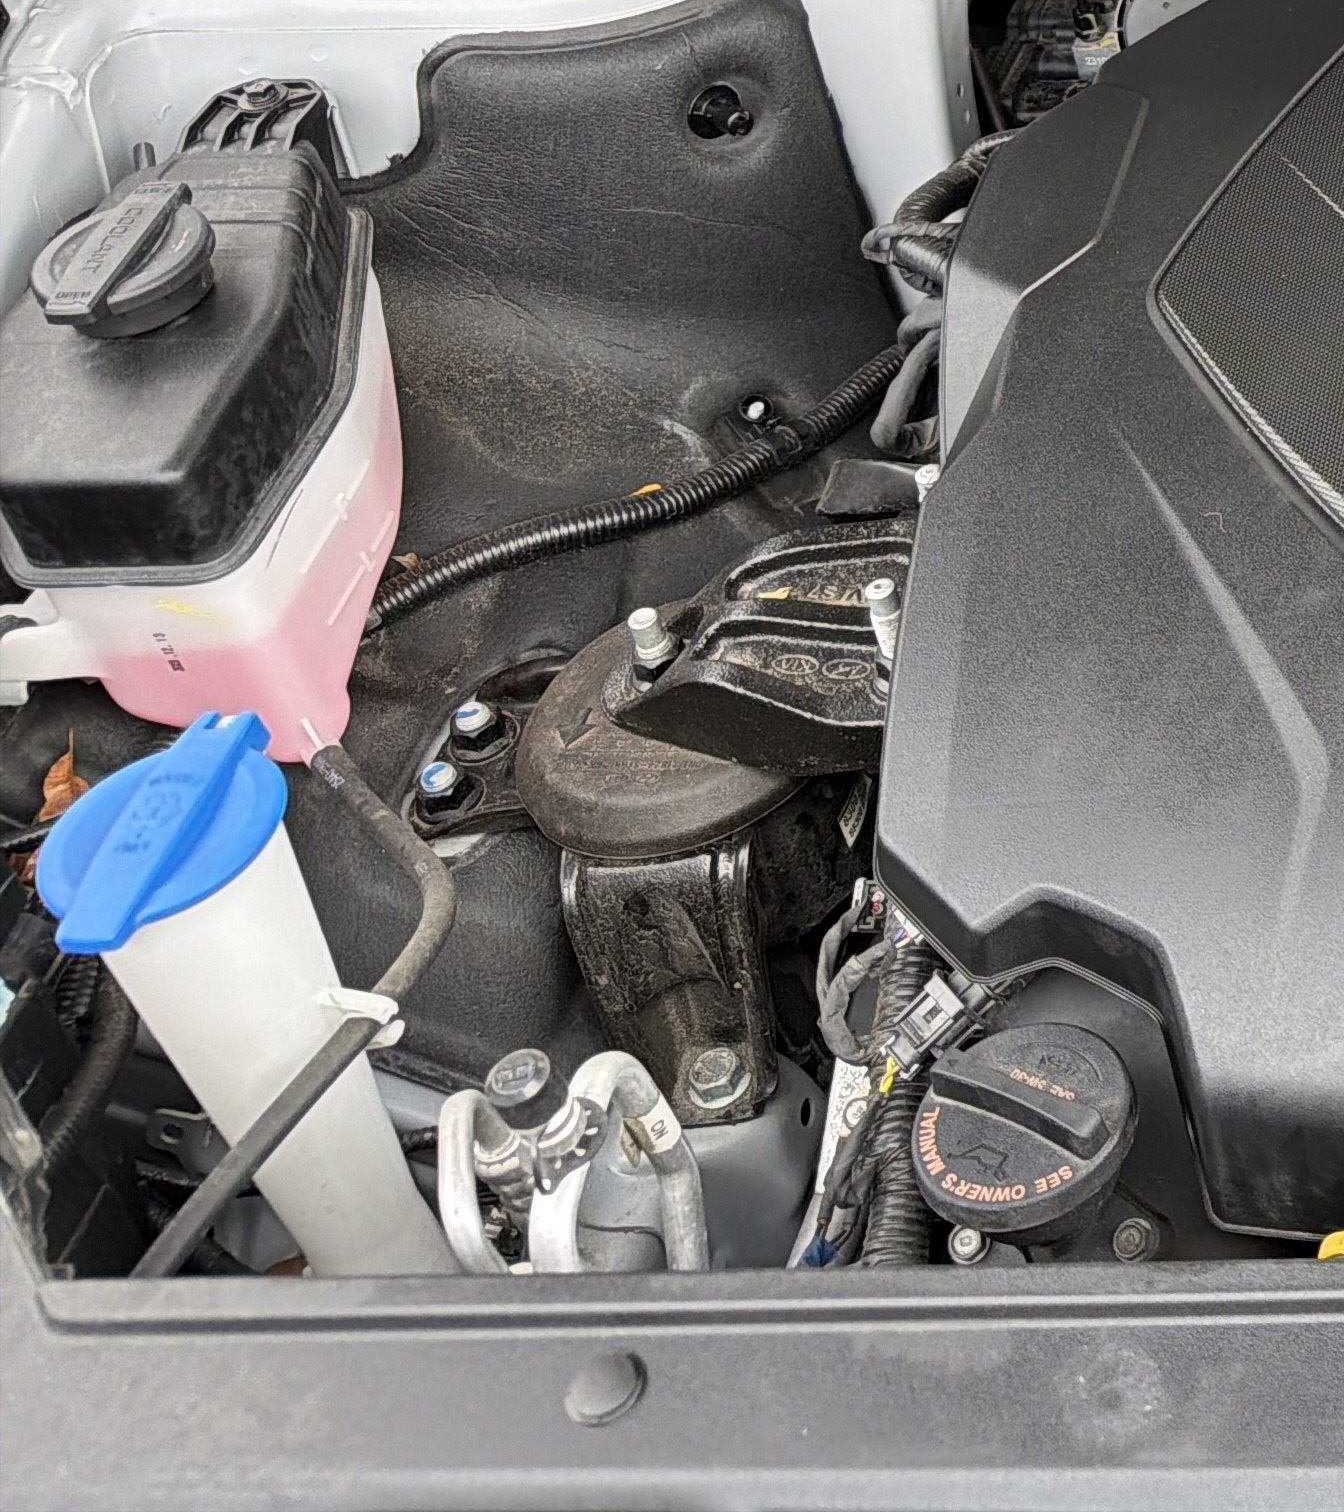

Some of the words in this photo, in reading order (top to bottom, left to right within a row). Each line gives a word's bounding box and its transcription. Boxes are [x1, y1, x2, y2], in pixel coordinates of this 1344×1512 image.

[80, 207, 145, 274] COOLANT
[919, 1106, 946, 1176] MANUAL
[941, 1173, 1026, 1202] OWNER'S
[1034, 1165, 1074, 1193] SEE
